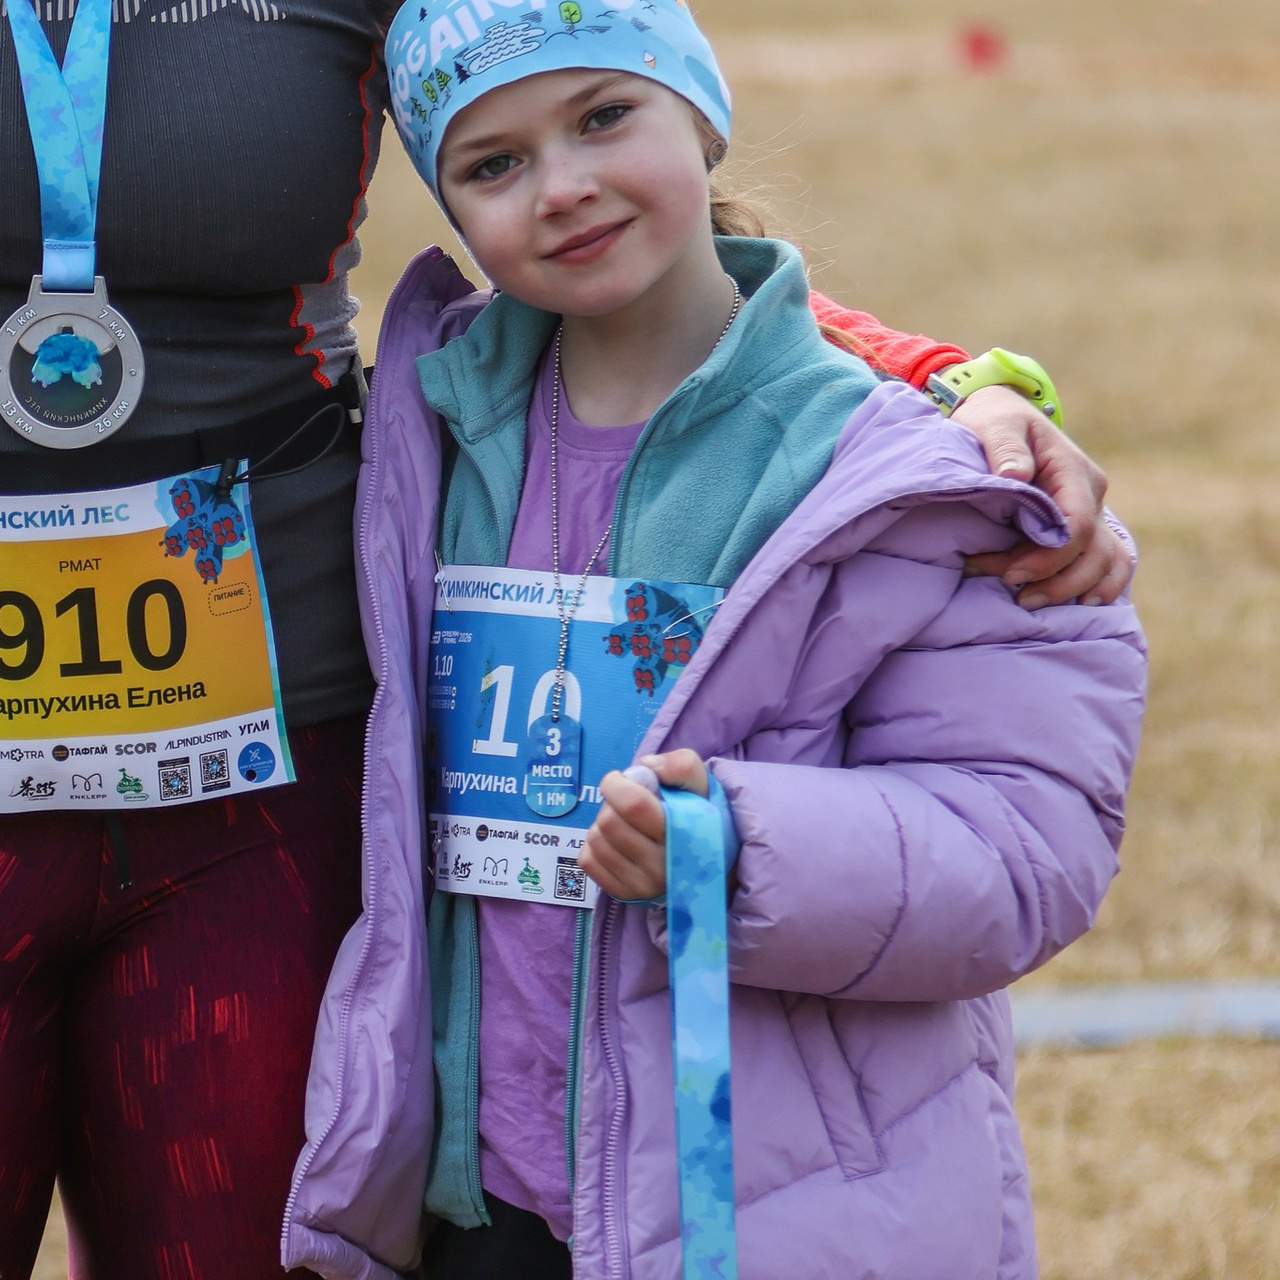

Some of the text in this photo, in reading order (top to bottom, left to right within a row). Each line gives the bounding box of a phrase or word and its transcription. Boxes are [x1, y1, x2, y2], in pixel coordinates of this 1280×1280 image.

[0, 400, 17, 416] 13
[94, 417, 112, 434] 26
[81, 503, 131, 525] ЛЕС
[59, 558, 103, 573] РМАТ
[213, 587, 246, 602] ПИТАНИЕ
[126, 680, 208, 709] Елена
[164, 729, 232, 751] ALPINDUSTRIA
[545, 727, 562, 757] 3
[69, 745, 108, 756] ТАФГАЙ
[114, 741, 158, 756] SCOR
[532, 764, 573, 778] место
[441, 767, 518, 795] Карпухина
[536, 792, 566, 806] 1 КМ
[489, 829, 519, 841] ТАФГАЙ
[523, 832, 560, 847] SCOR
